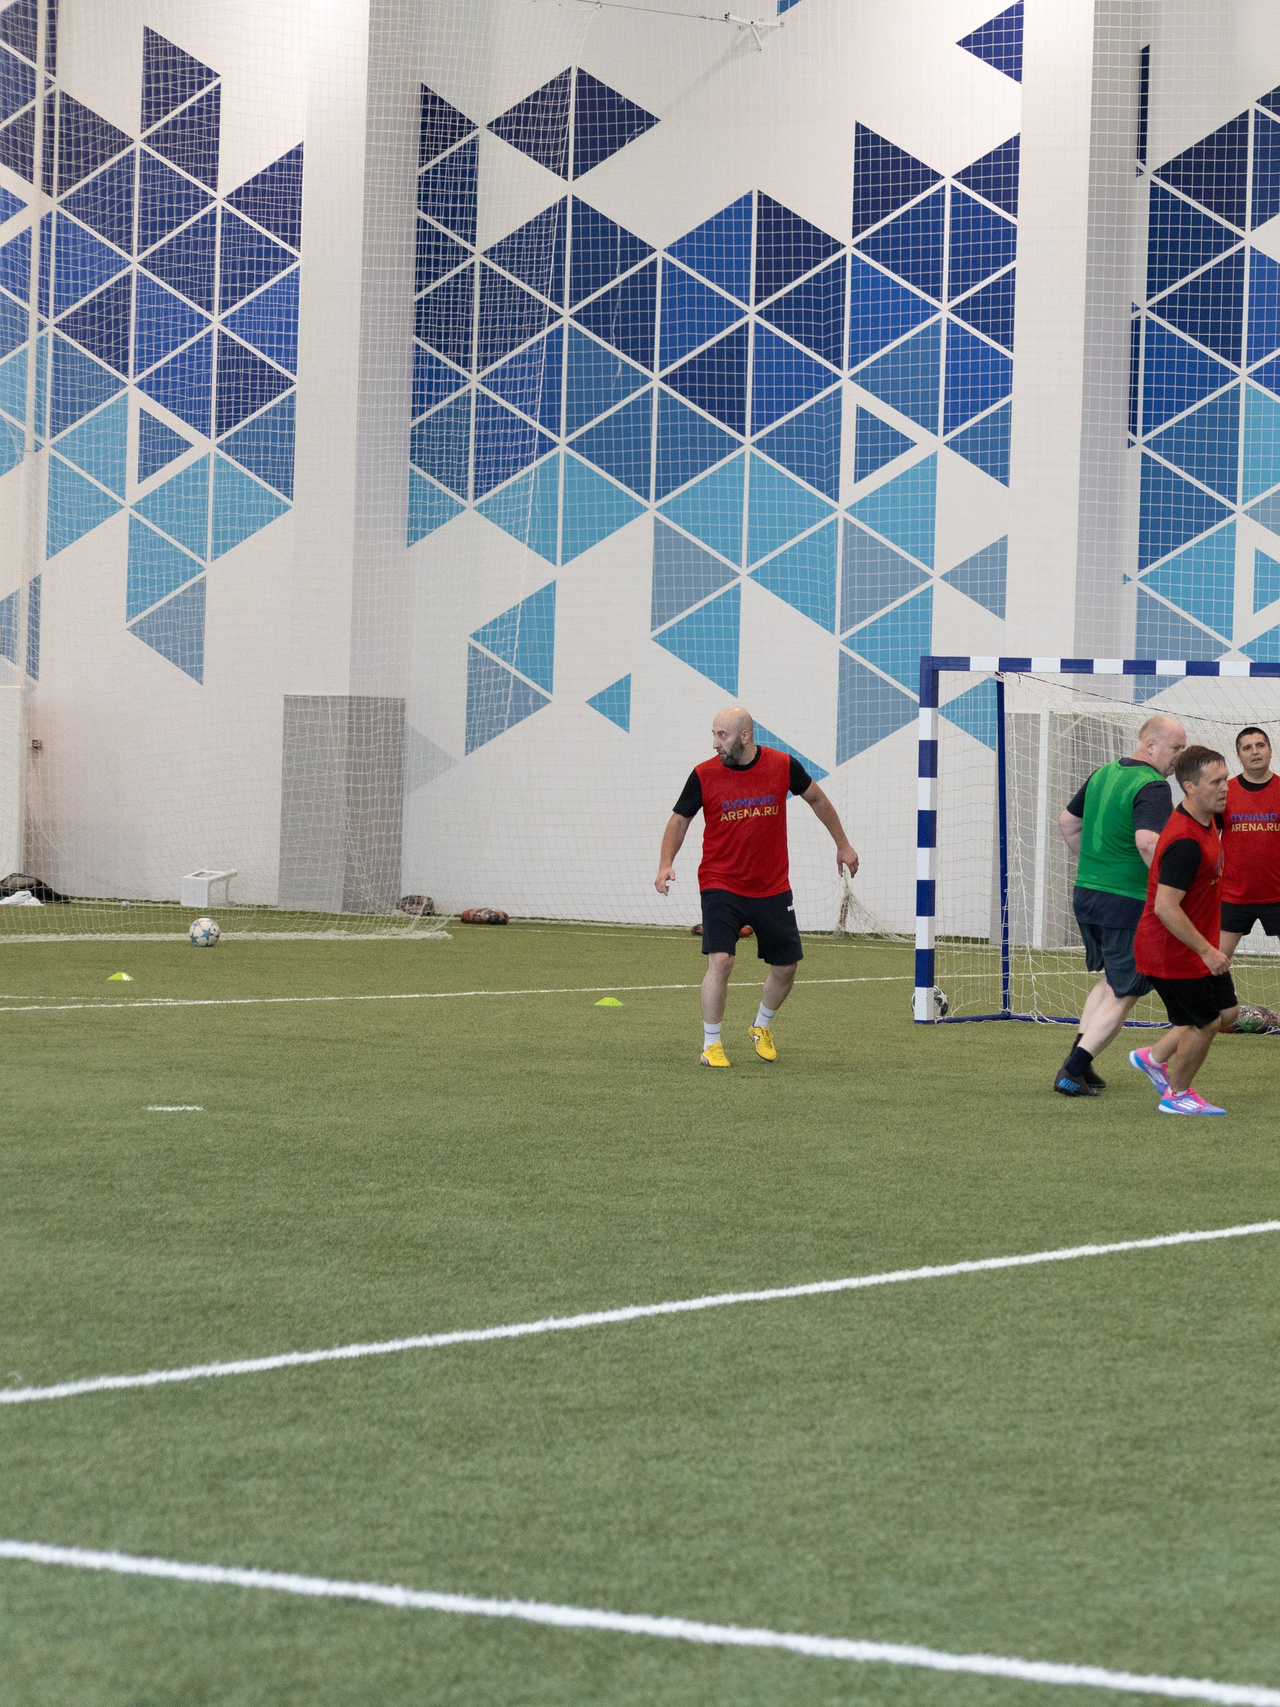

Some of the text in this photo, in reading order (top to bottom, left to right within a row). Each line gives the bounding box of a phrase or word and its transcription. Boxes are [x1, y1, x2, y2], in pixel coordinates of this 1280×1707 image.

[721, 794, 776, 811] DYNAMO
[720, 806, 779, 822] ARENA.RU
[1230, 812, 1278, 823] DYNAMO
[1231, 822, 1280, 833] ARENA.RU
[1058, 1077, 1081, 1093] NIKE
